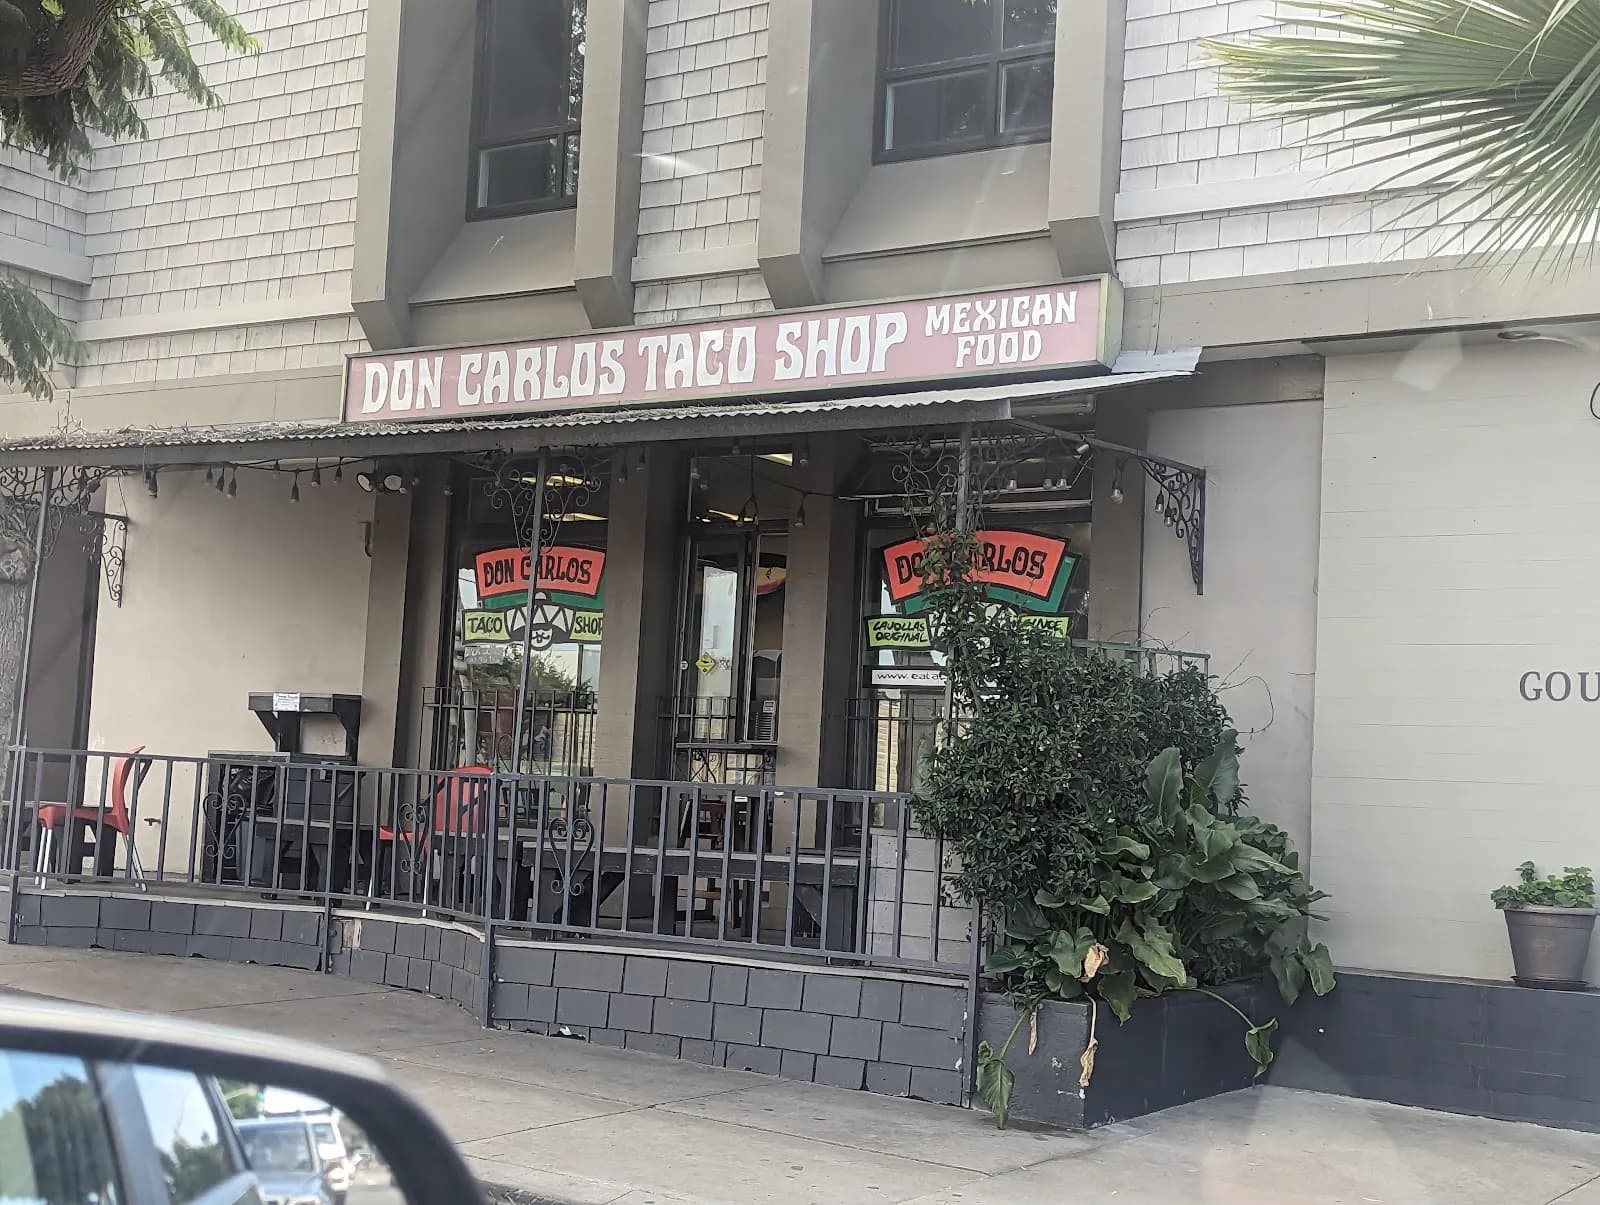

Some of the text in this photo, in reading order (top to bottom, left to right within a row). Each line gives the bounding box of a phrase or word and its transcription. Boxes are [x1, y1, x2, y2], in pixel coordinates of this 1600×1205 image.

[924, 290, 1078, 337] MEXICAN
[361, 311, 908, 414] DON CARLOS TACO SHOP
[955, 329, 1042, 368] FOOD
[483, 557, 515, 588] DON
[467, 616, 503, 634] TACO
[875, 631, 929, 643] ORIGINAL
[1519, 671, 1600, 702] GOU
